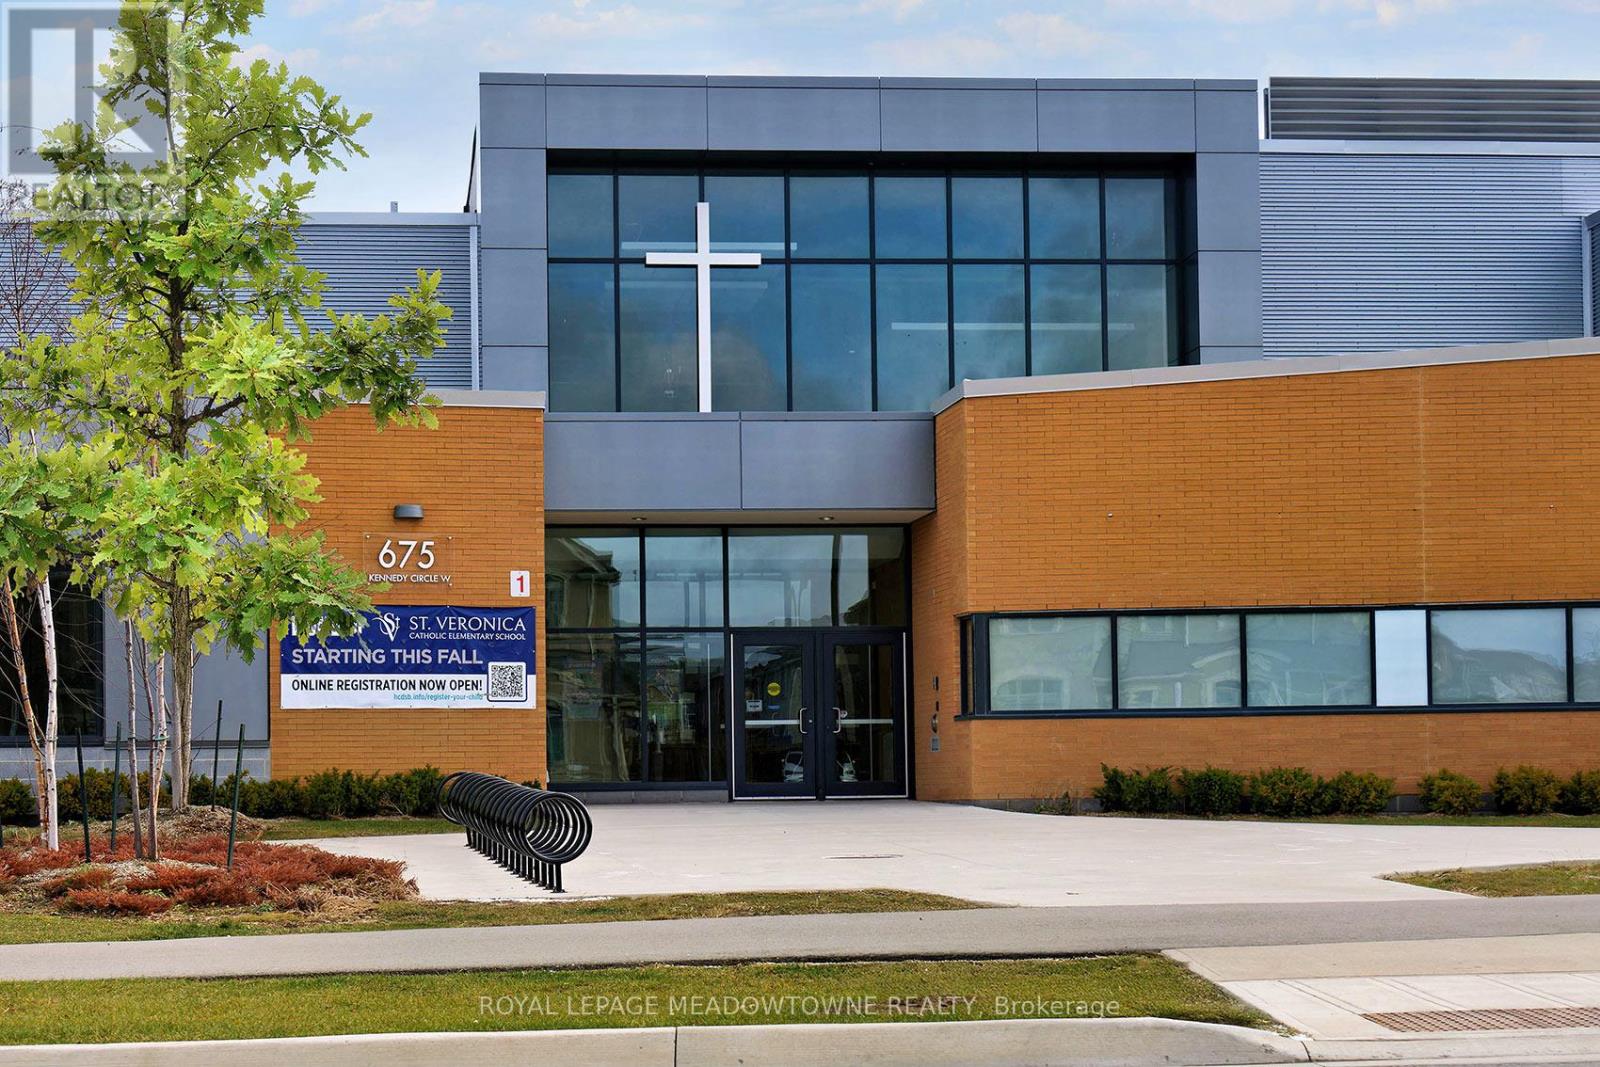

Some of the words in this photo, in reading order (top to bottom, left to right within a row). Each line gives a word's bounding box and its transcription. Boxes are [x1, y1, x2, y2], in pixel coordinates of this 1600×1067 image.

[378, 539, 435, 569] 675
[369, 574, 408, 583] KENNEDY
[410, 574, 438, 583] CIRCLE
[516, 575, 523, 593] 1
[409, 616, 431, 630] ST.
[436, 616, 526, 631] VERONICA
[409, 632, 447, 640] CATHOLIC
[448, 632, 494, 640] ELEMENTARY
[292, 648, 386, 664] STARTING
[391, 648, 432, 664] THIS
[437, 649, 484, 664] FALL
[292, 679, 334, 691] ONLINE
[336, 679, 416, 691] REGISTRATION
[419, 679, 446, 691] NOW
[449, 679, 483, 691] OPEN!
